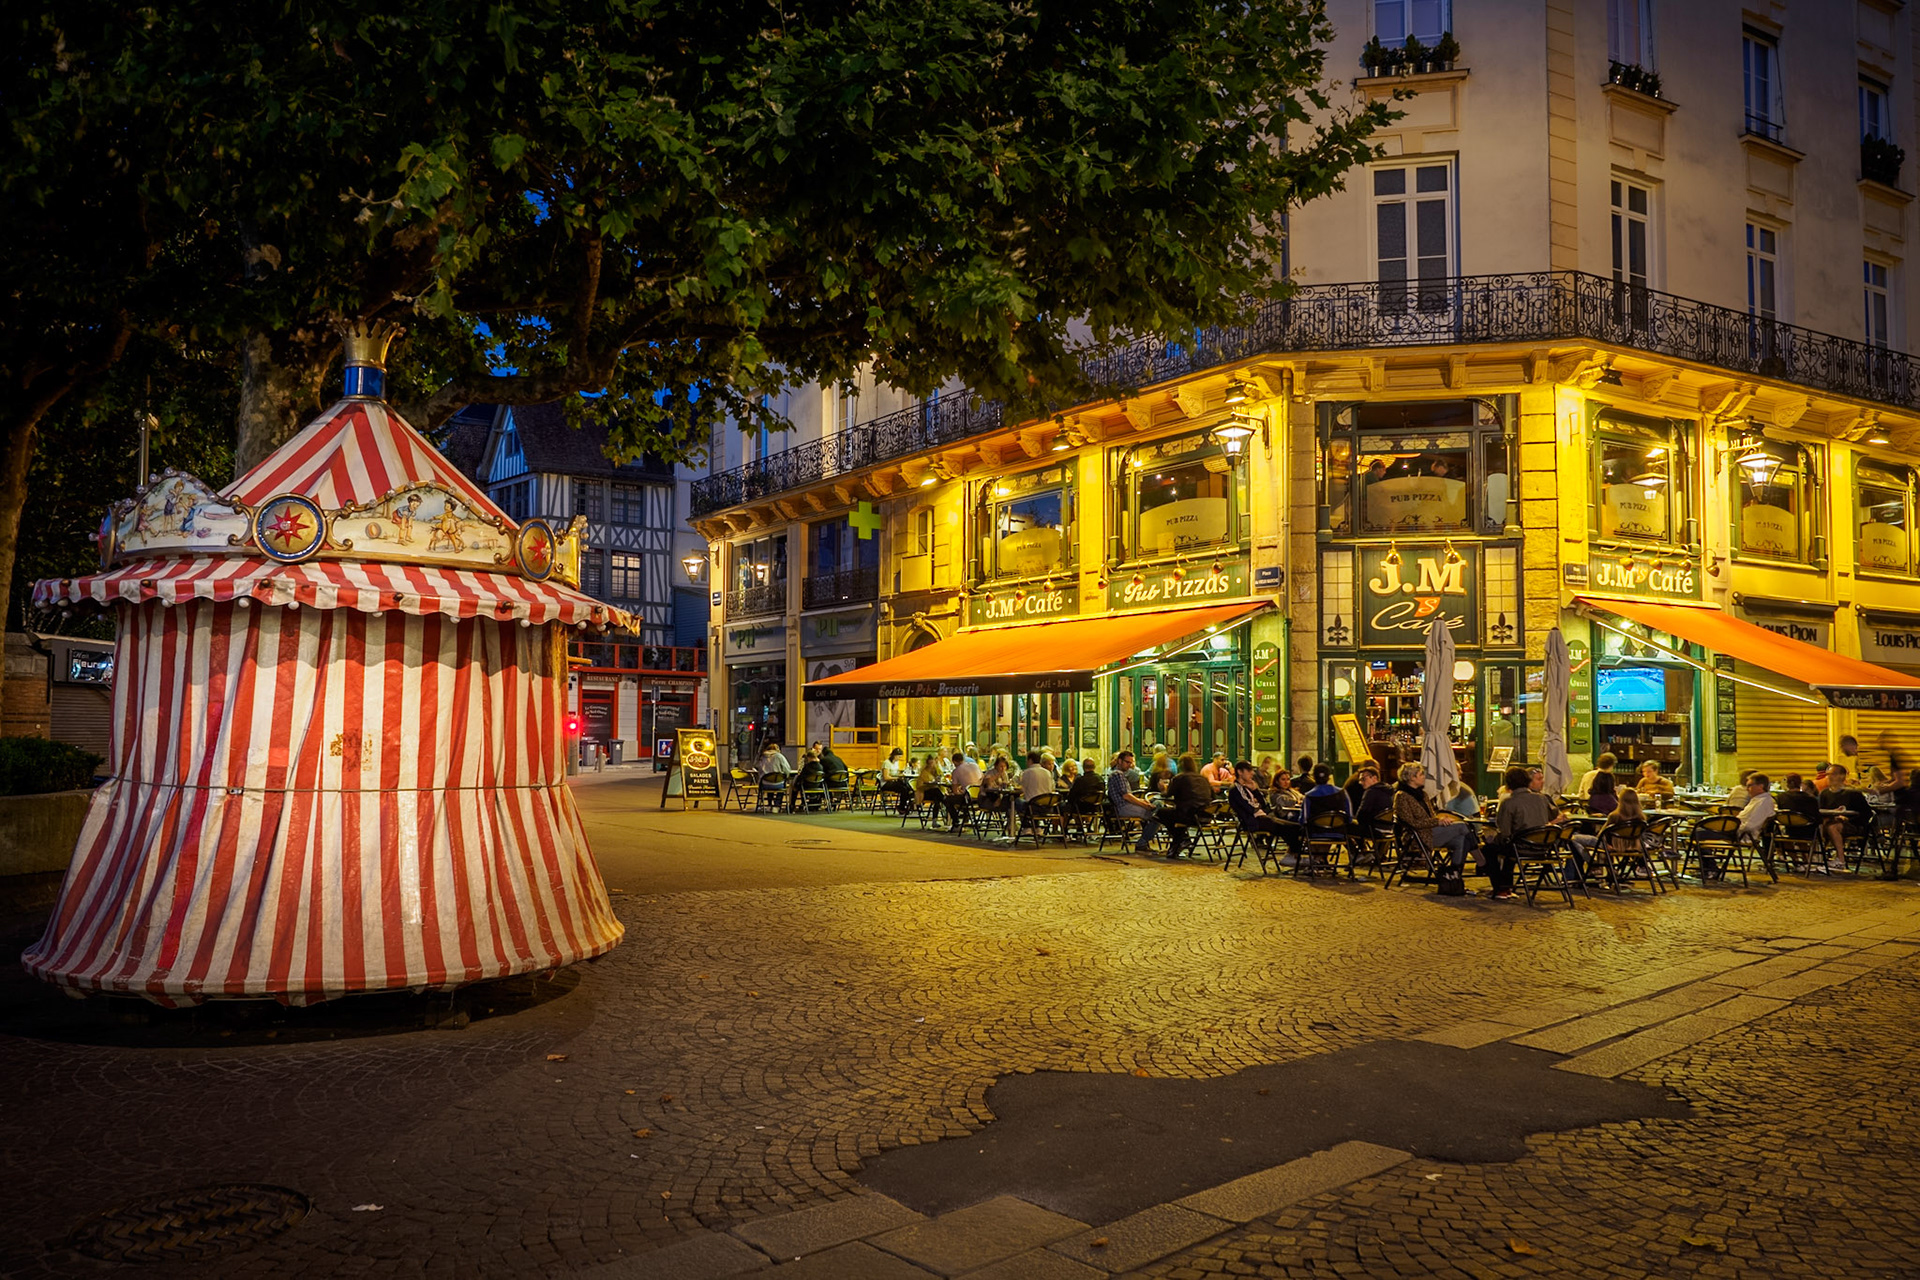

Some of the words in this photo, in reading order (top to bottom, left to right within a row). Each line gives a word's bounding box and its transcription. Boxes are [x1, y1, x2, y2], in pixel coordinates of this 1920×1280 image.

[1390, 494, 1410, 503] PUB
[1412, 493, 1442, 502] PIZZA
[1162, 574, 1229, 599] Pizzas
[1369, 558, 1467, 595] J.M
[1648, 568, 1694, 594] Café
[1024, 589, 1063, 615] Café
[937, 682, 980, 695] Brasserie
